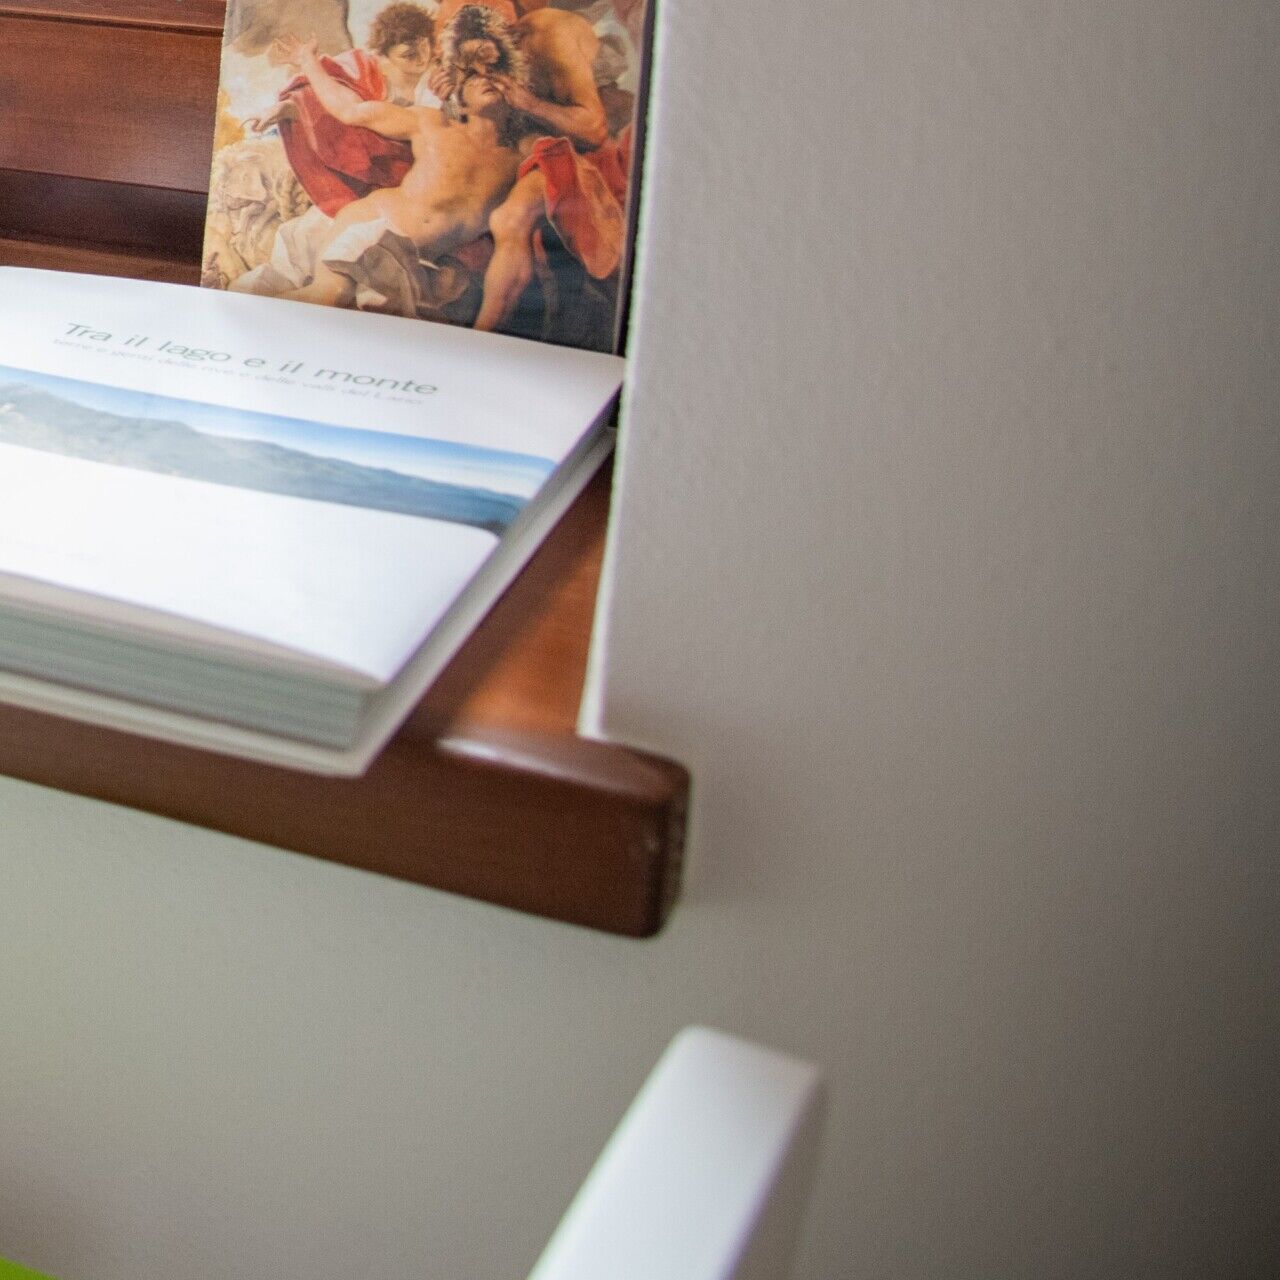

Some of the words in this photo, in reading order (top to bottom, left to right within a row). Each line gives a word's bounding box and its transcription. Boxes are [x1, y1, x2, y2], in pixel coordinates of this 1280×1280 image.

[65, 322, 113, 342] Tra
[123, 334, 150, 348] il
[157, 340, 232, 362] lago
[243, 357, 266, 369] e
[279, 360, 304, 374] il
[313, 368, 438, 395] monte
